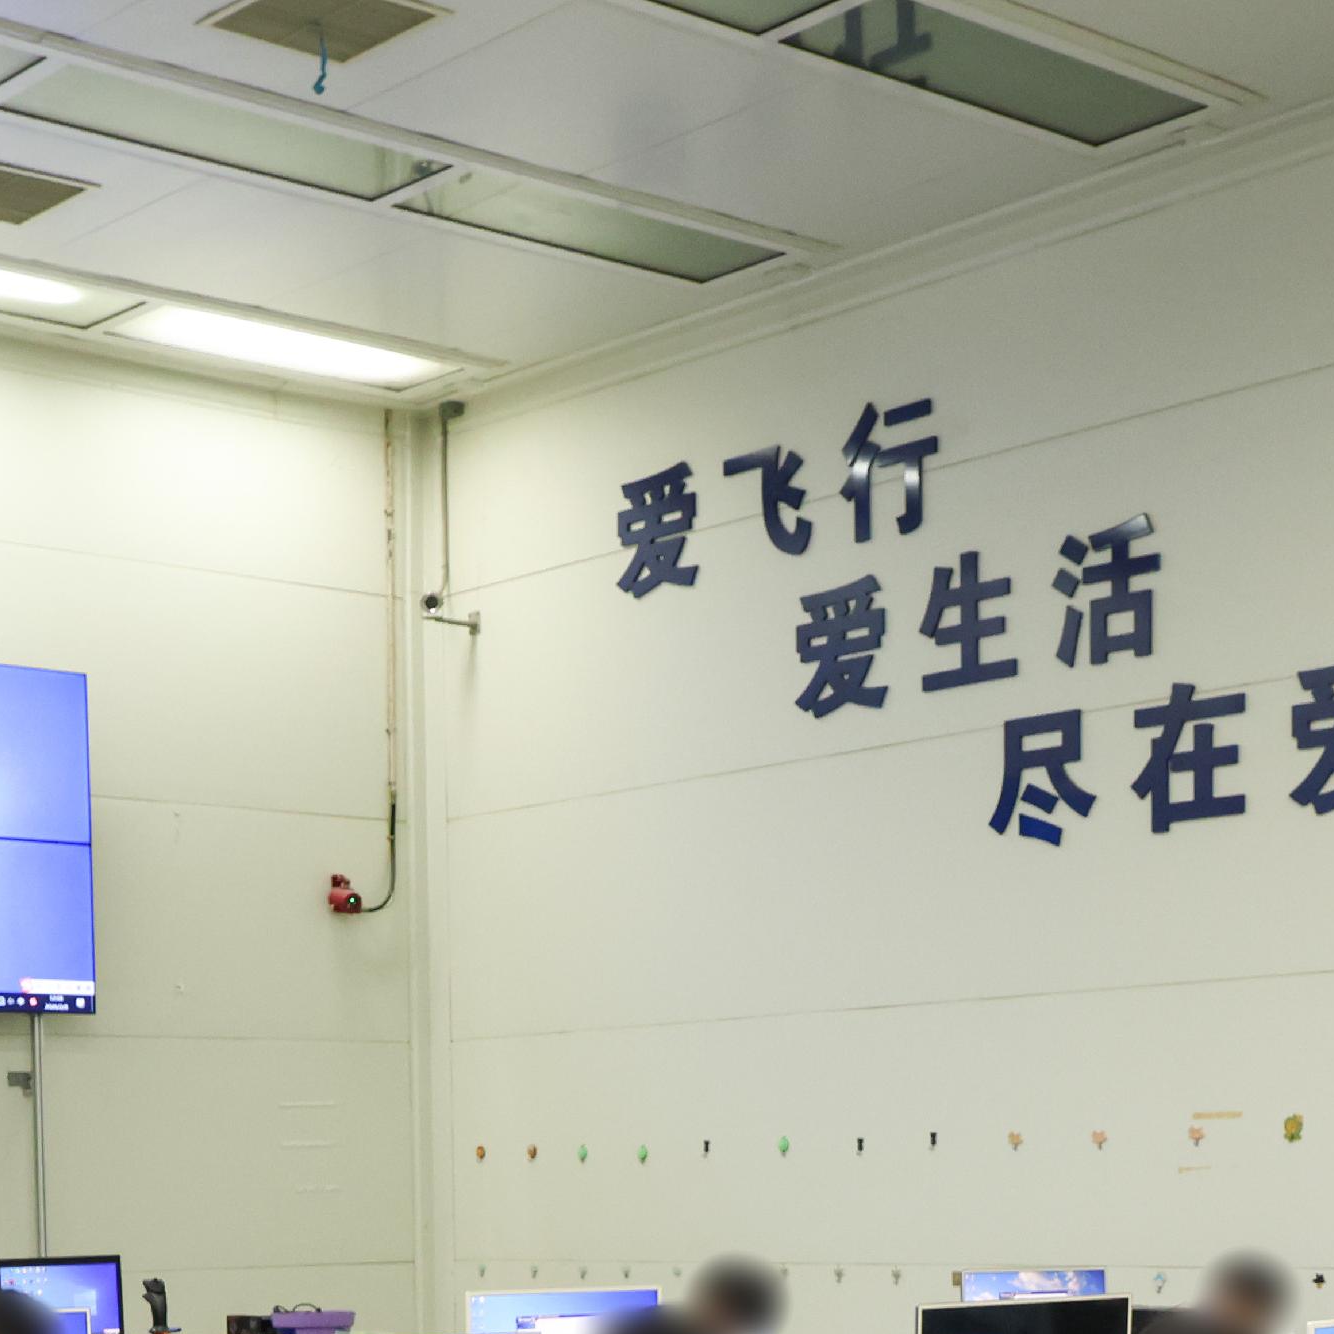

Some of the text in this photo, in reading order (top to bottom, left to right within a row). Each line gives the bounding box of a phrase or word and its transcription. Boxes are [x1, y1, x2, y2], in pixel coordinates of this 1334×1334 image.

[617, 398, 939, 599] 爱飞行
[795, 512, 1161, 720] 爱生活
